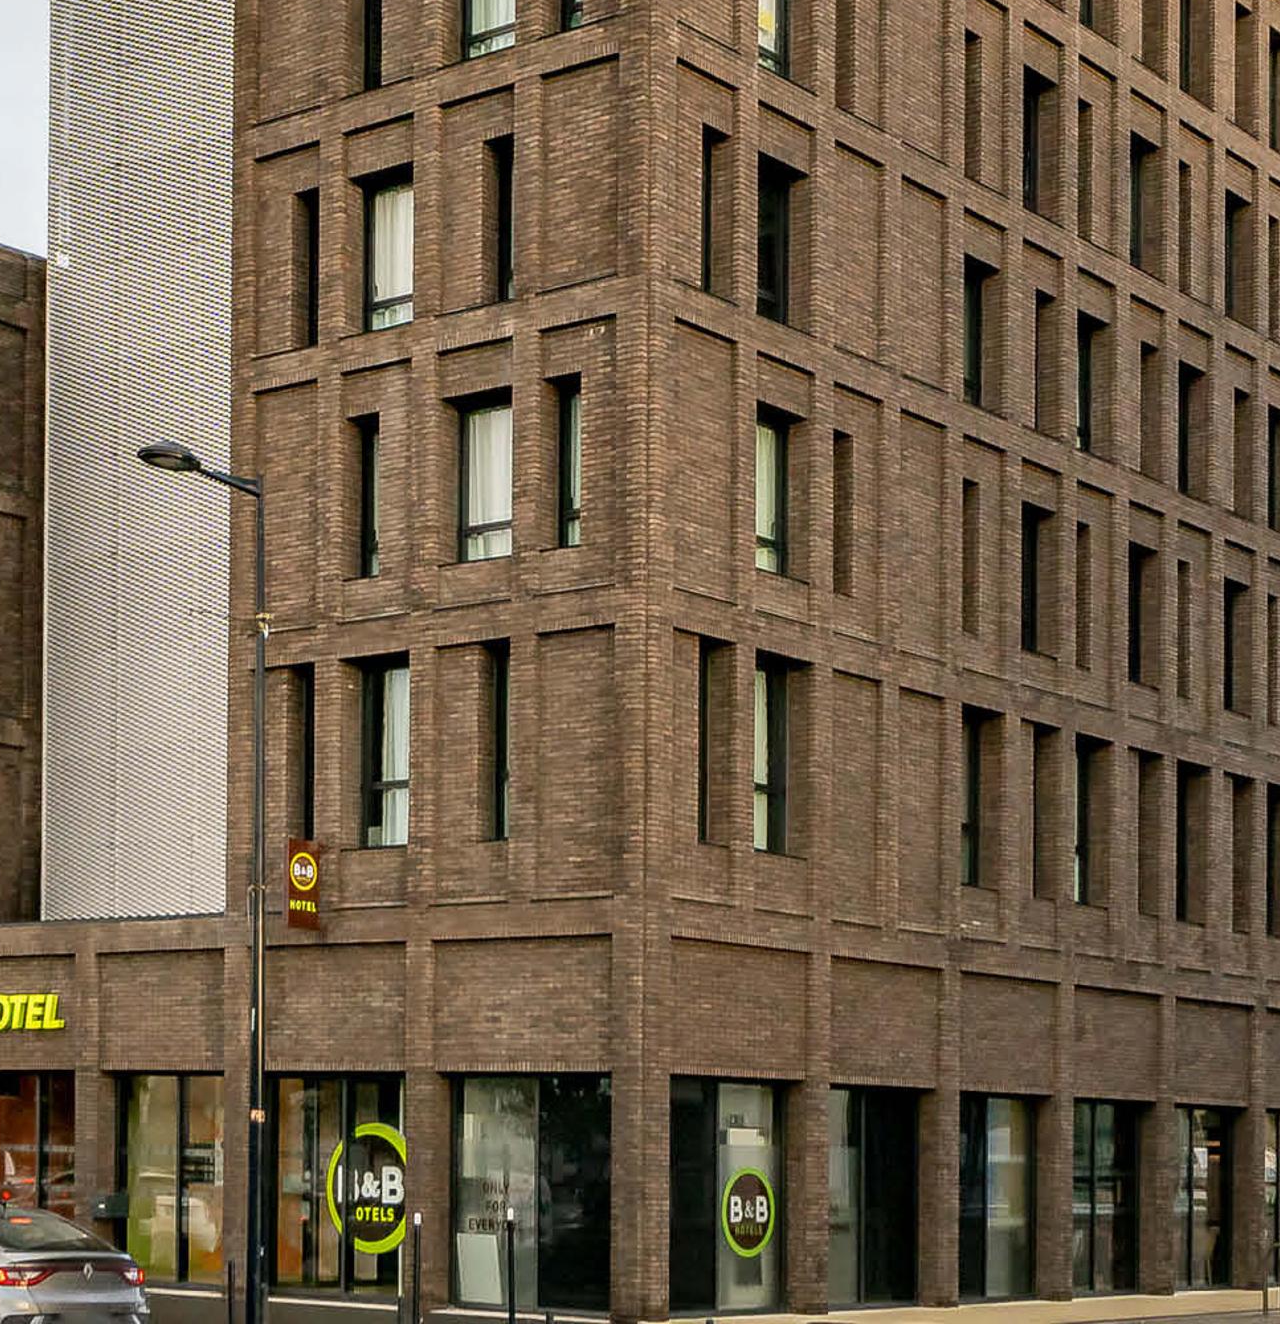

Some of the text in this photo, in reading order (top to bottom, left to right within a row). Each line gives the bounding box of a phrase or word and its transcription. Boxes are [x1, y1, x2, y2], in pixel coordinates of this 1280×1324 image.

[289, 899, 316, 913] HOTEL
[355, 1206, 395, 1223] OTELS
[730, 1195, 768, 1223] B&B
